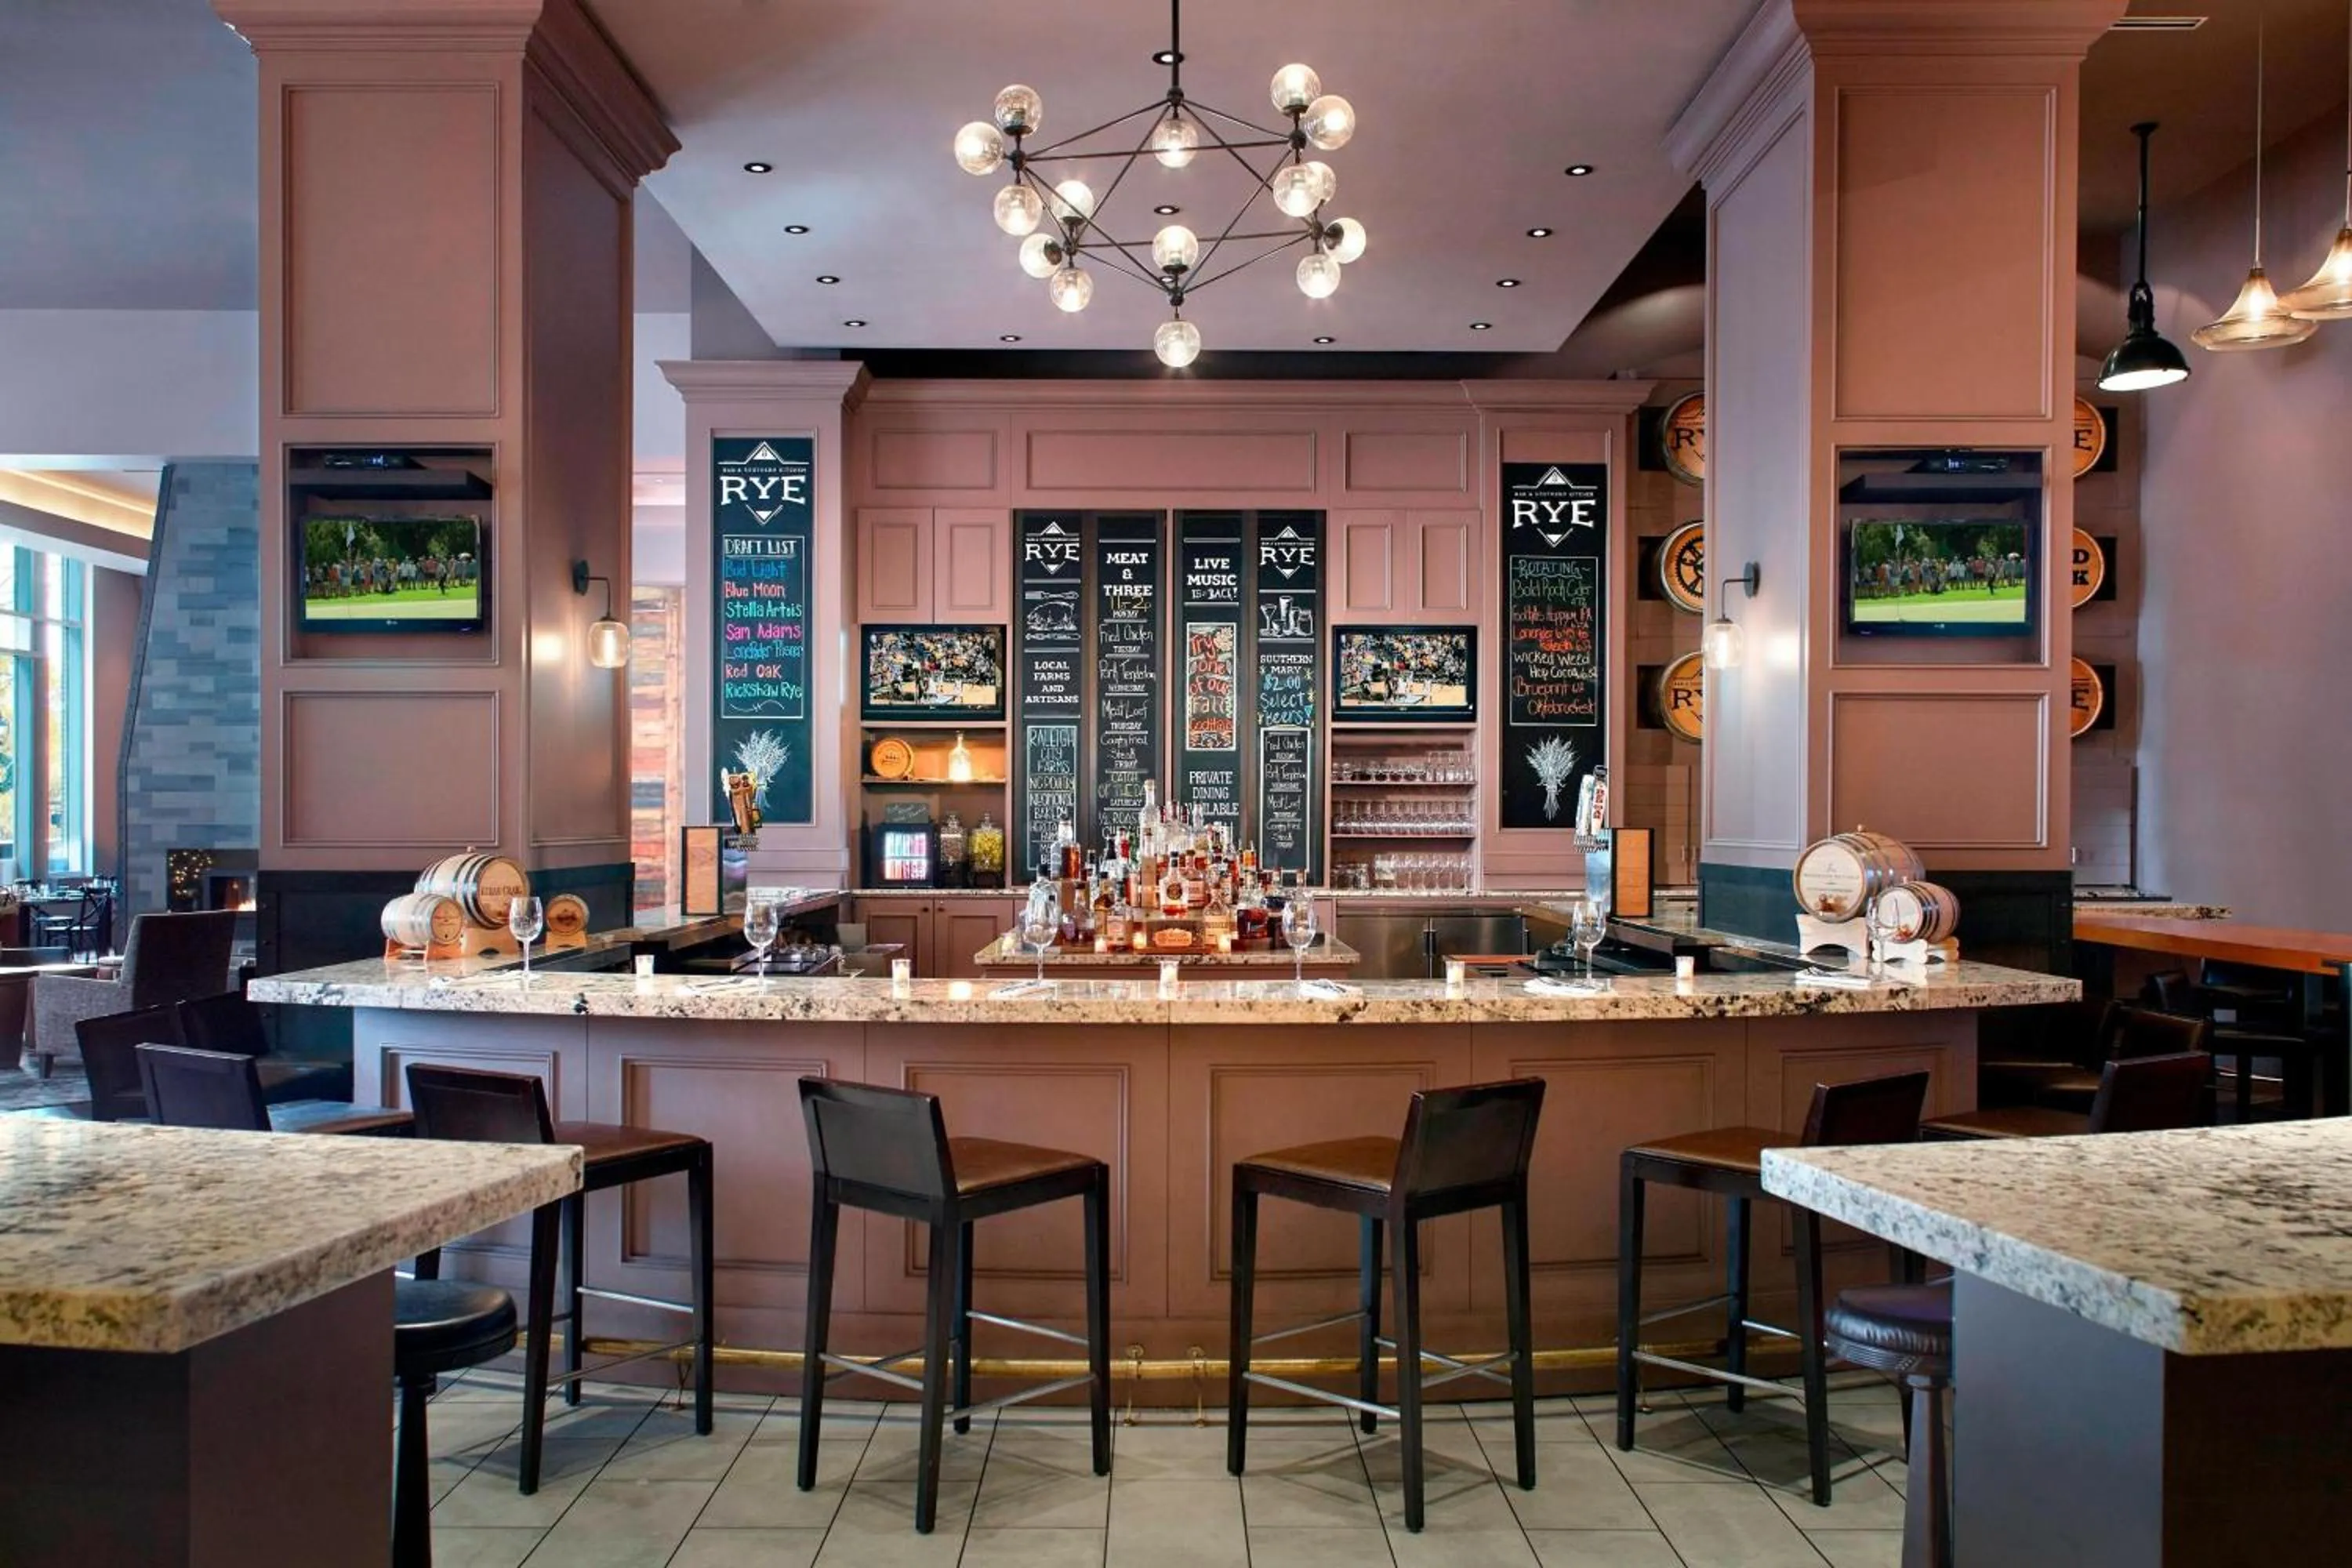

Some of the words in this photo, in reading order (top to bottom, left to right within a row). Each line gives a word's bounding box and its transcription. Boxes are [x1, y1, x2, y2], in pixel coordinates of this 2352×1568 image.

[720, 475, 806, 505] RYE
[1512, 499, 1596, 528] RYE
[724, 539, 762, 554] DRAFT
[768, 539, 797, 554] LIST
[1025, 543, 1080, 561] RYE
[1106, 553, 1149, 564] MEAT
[1194, 557, 1230, 569] LIVE
[1260, 546, 1315, 565] RYE
[1122, 568, 1133, 579] &
[1186, 574, 1238, 586] MUSIC
[724, 581, 749, 599] Blue
[753, 583, 786, 597] Moon
[1103, 585, 1153, 597] THREE
[725, 601, 764, 618] Stella
[766, 601, 802, 618] Artois
[726, 624, 750, 640] Sam
[757, 622, 802, 640] Adams
[1190, 634, 1216, 658] Try
[1034, 661, 1070, 670] LOCAL
[1260, 655, 1313, 664] SOUTHERN
[725, 662, 747, 678] Red
[1033, 672, 1070, 681] FARMS
[1271, 666, 1301, 674] MARY
[780, 681, 802, 699] Rye
[1260, 691, 1305, 710] Select
[1029, 729, 1075, 747] RALEIGH
[1037, 760, 1070, 774] FARMS
[1189, 771, 1233, 784] PRIVATE
[1192, 786, 1229, 799] DINING
